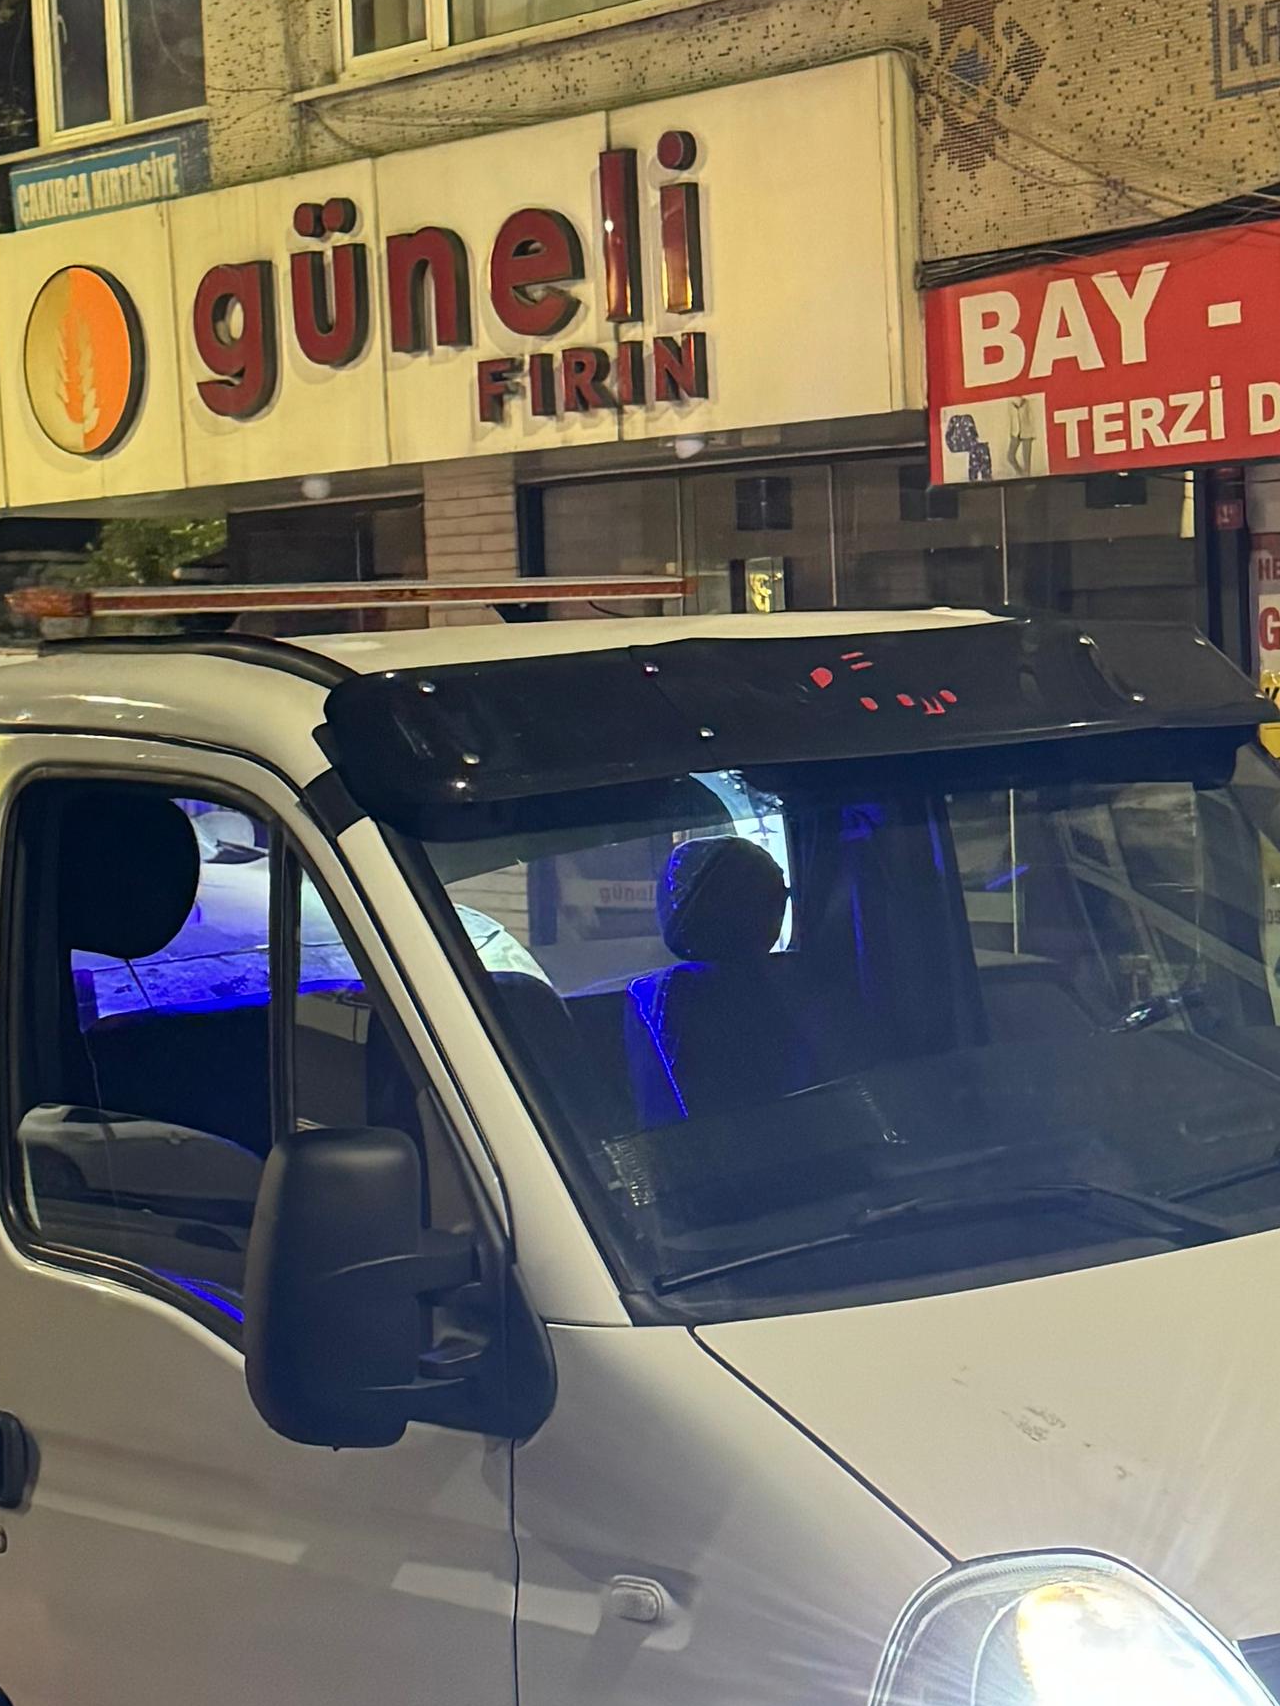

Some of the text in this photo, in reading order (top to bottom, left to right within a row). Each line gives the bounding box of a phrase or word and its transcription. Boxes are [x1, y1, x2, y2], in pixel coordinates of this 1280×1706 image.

[193, 129, 706, 420] güneli
[958, 261, 1171, 388] BAY
[478, 331, 709, 424] FIRIN
[1053, 376, 1228, 459] TERZİ
